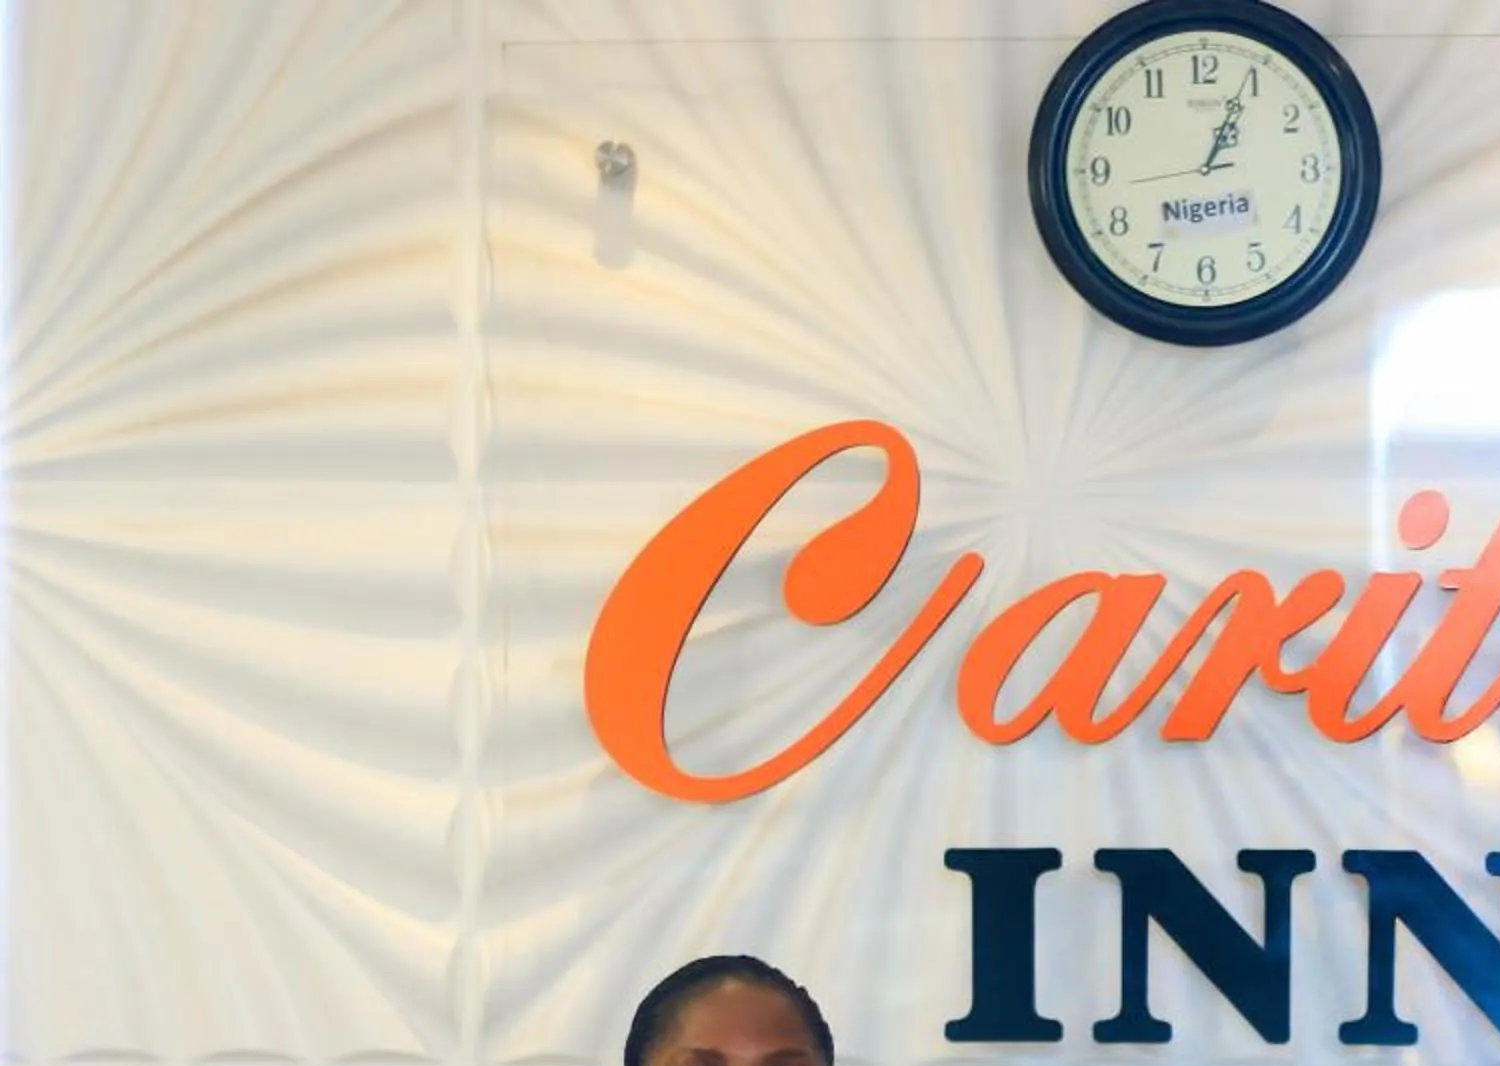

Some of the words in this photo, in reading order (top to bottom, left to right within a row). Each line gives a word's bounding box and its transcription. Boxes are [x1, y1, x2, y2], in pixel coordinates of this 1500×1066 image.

[1143, 68, 1165, 99] 11
[1190, 54, 1219, 85] 12
[1248, 67, 1259, 97] 1
[1105, 105, 1132, 136] 10
[1282, 104, 1300, 134] 2
[1090, 156, 1111, 186] 9
[1301, 154, 1320, 184] 3
[1109, 206, 1129, 236] 8
[1161, 194, 1250, 223] Nigeria
[1282, 204, 1302, 235] 4
[1147, 242, 1165, 273] 7
[1196, 255, 1216, 285] 6
[1246, 242, 1266, 272] 5
